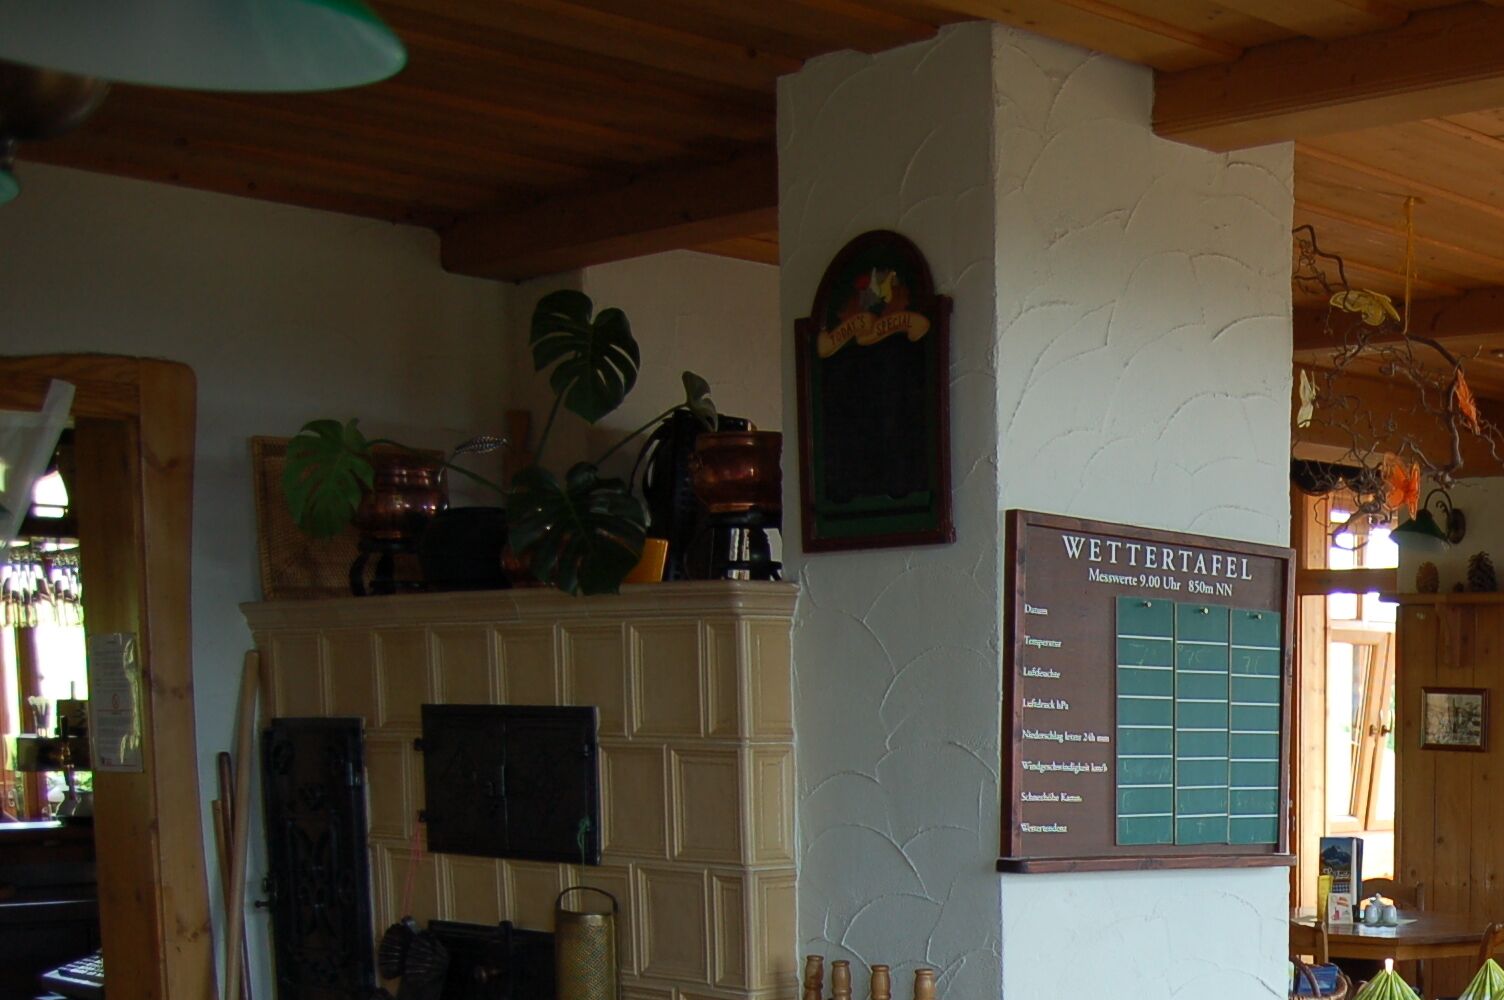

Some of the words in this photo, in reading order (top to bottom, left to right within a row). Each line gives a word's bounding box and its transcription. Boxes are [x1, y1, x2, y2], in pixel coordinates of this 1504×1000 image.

[830, 315, 866, 345] TODAY'S
[875, 313, 912, 336] SPECIAL
[1062, 535, 1252, 580] WETTERTAFEL
[1088, 567, 1138, 587] Messwerte
[1139, 574, 1160, 589] 9.00
[1163, 576, 1182, 591] Uhr
[1188, 581, 1213, 595] 850m
[1216, 582, 1233, 597] NN
